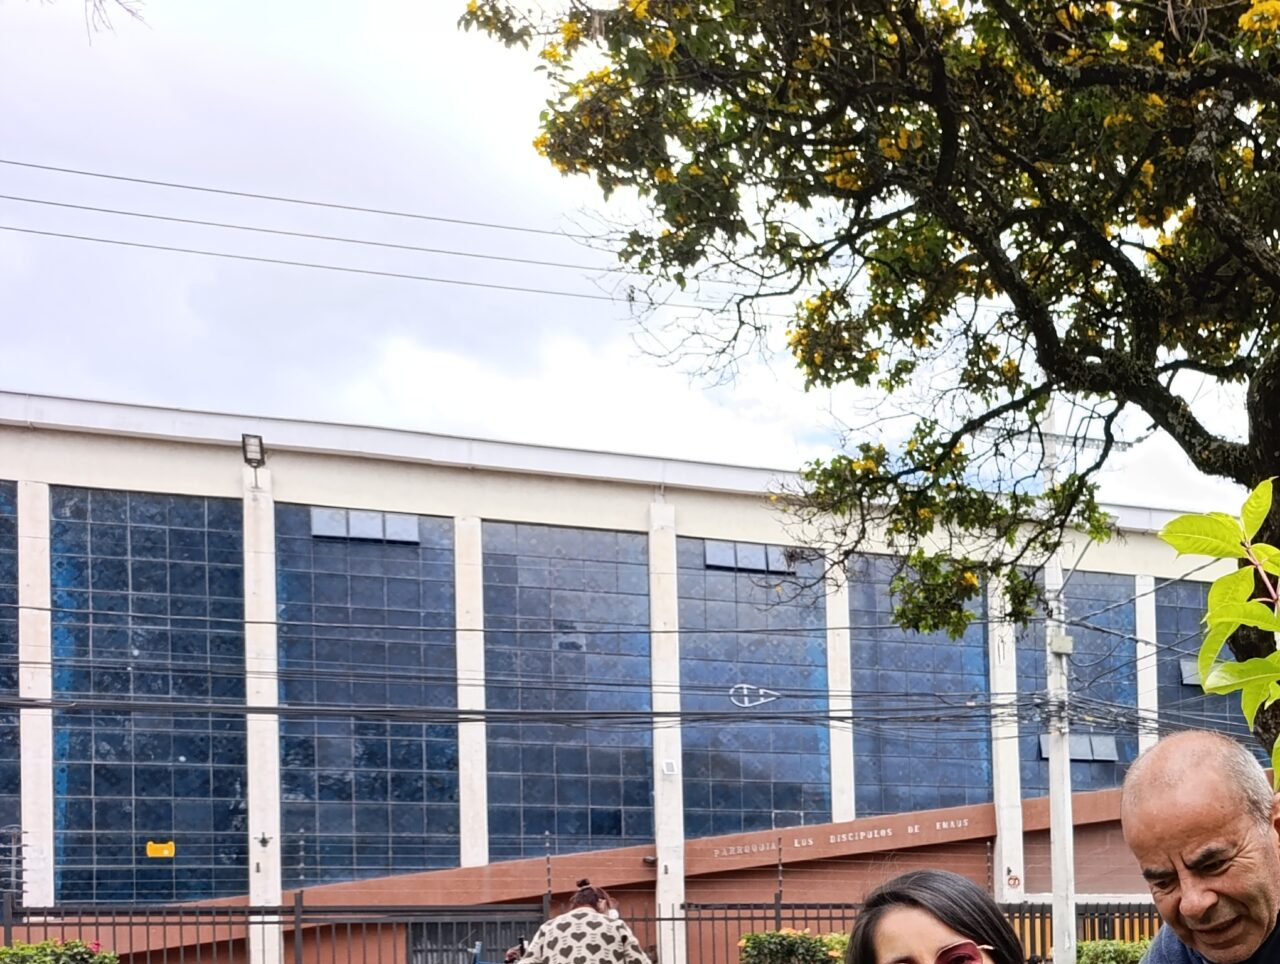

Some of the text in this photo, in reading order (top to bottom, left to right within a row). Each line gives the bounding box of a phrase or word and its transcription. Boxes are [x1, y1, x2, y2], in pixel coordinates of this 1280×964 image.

[713, 818, 969, 858] PARROQUIA LOS DISCIPULOS DE EMAUS
